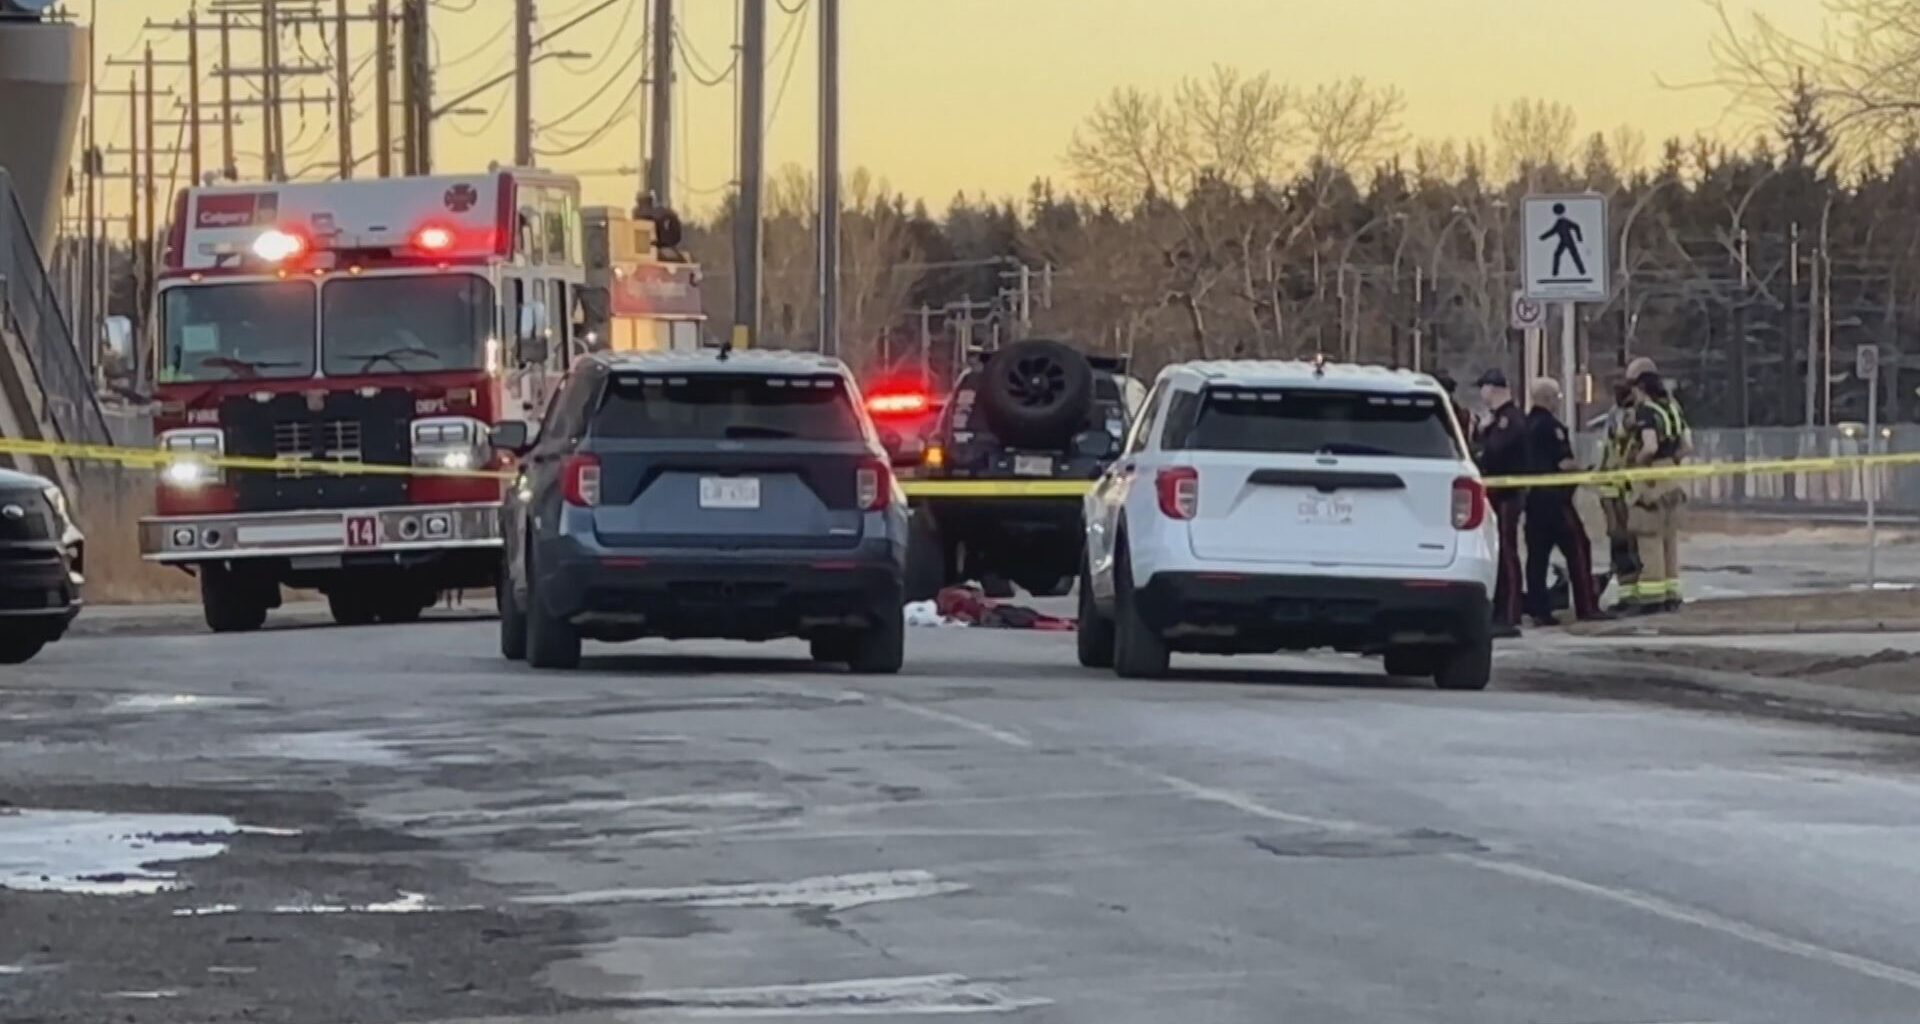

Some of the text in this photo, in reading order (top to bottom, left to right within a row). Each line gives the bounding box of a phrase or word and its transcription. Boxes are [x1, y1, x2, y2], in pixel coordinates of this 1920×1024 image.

[200, 211, 250, 225] Calgary
[188, 408, 219, 424] FIRE
[349, 519, 373, 545] 14
